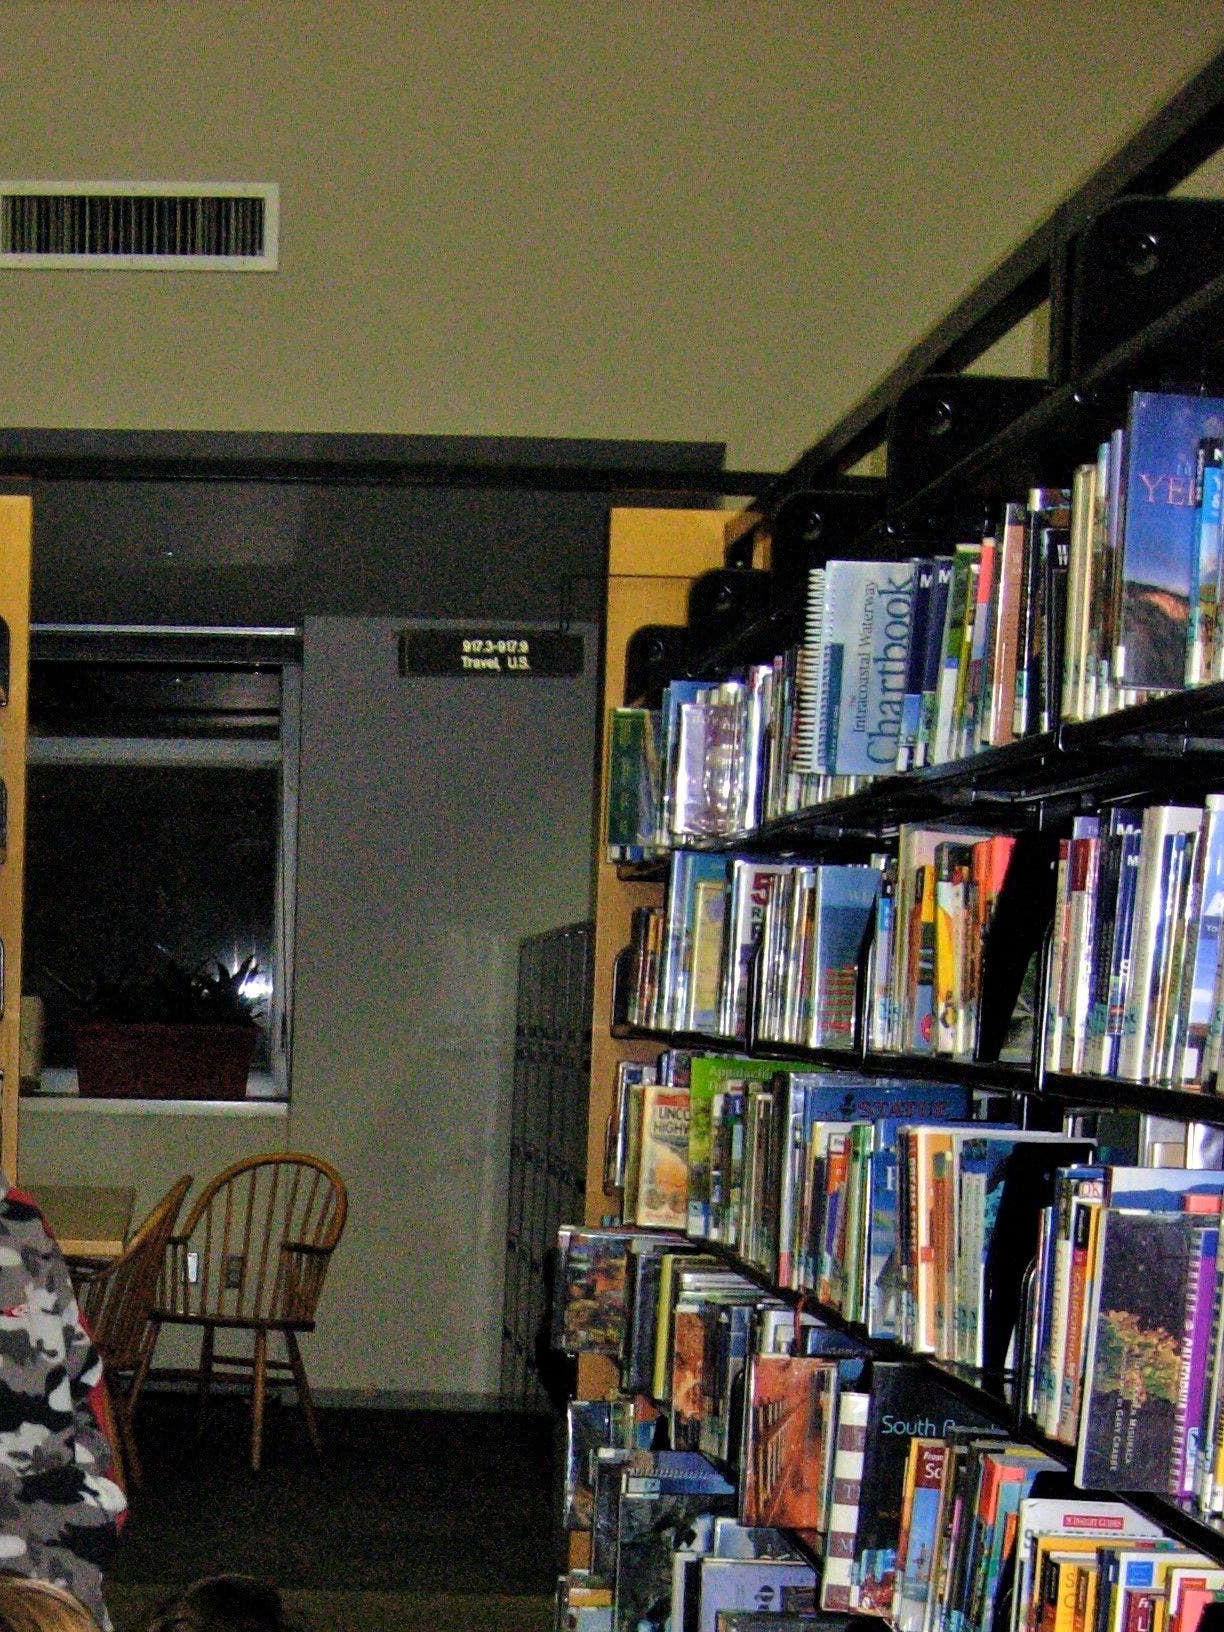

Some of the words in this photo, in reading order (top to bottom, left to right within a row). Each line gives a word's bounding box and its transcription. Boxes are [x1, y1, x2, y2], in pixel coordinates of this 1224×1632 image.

[858, 580, 878, 646] Waterway
[852, 652, 871, 733] Intracoastal
[866, 577, 914, 764] Chartbook
[881, 1414, 936, 1437] South
